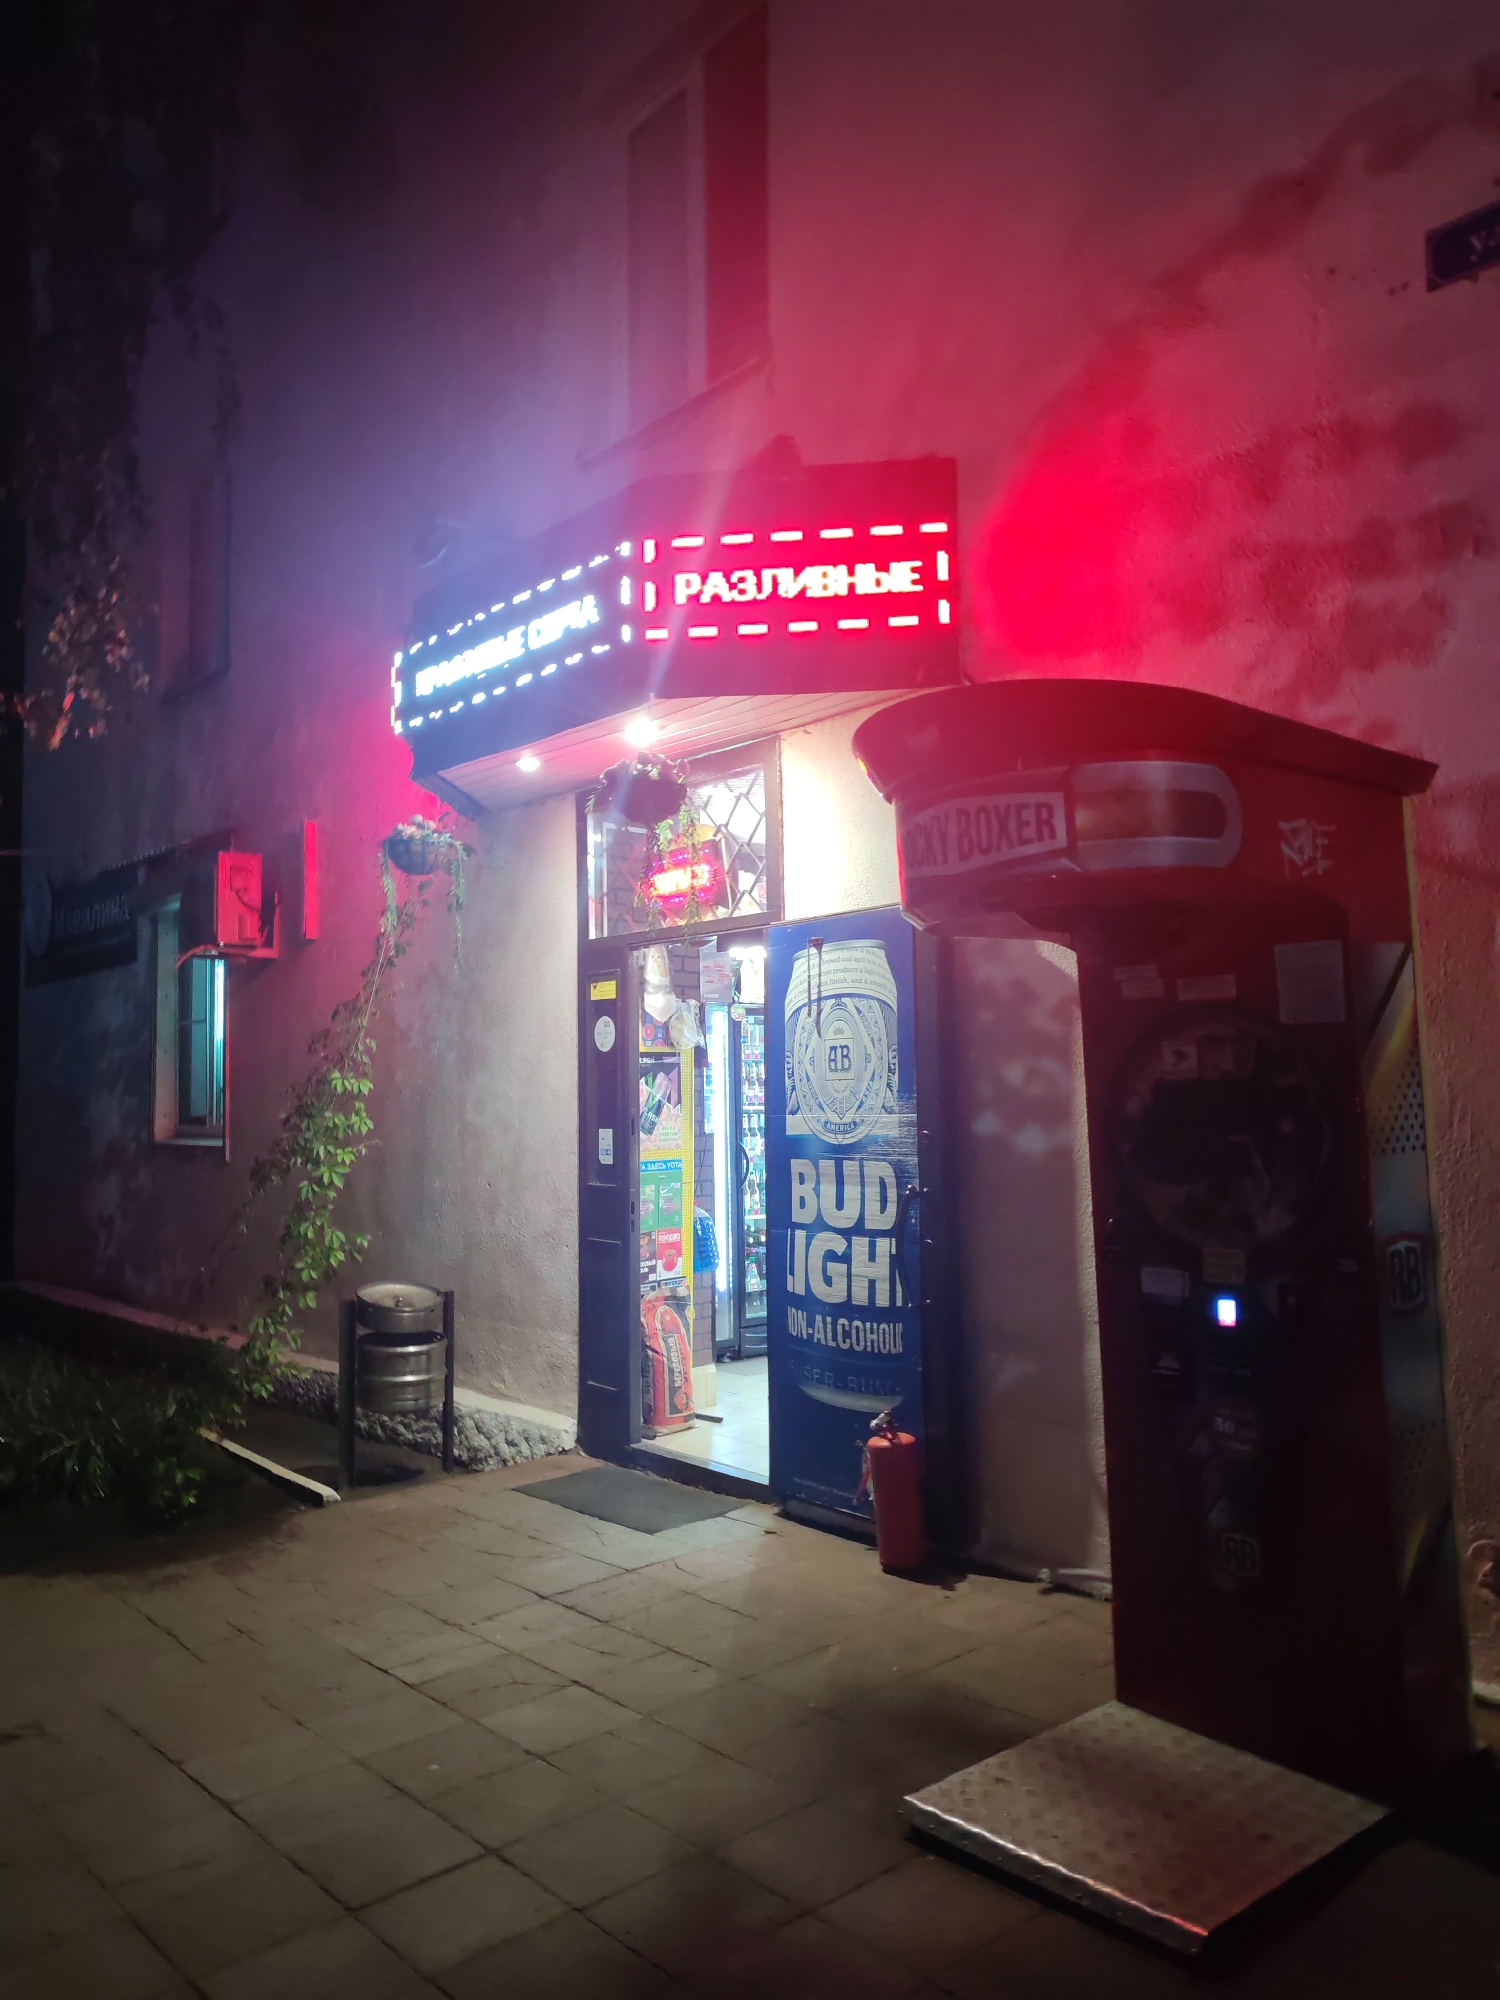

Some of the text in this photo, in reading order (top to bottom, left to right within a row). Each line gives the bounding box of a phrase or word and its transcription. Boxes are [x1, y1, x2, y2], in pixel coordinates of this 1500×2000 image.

[674, 560, 924, 606] РАЗЛИВНЫЕ
[905, 802, 1058, 869] OCKY BOXER
[828, 1045, 853, 1074] AB
[826, 1122, 855, 1132] AMERICA
[791, 1159, 898, 1230] BUD
